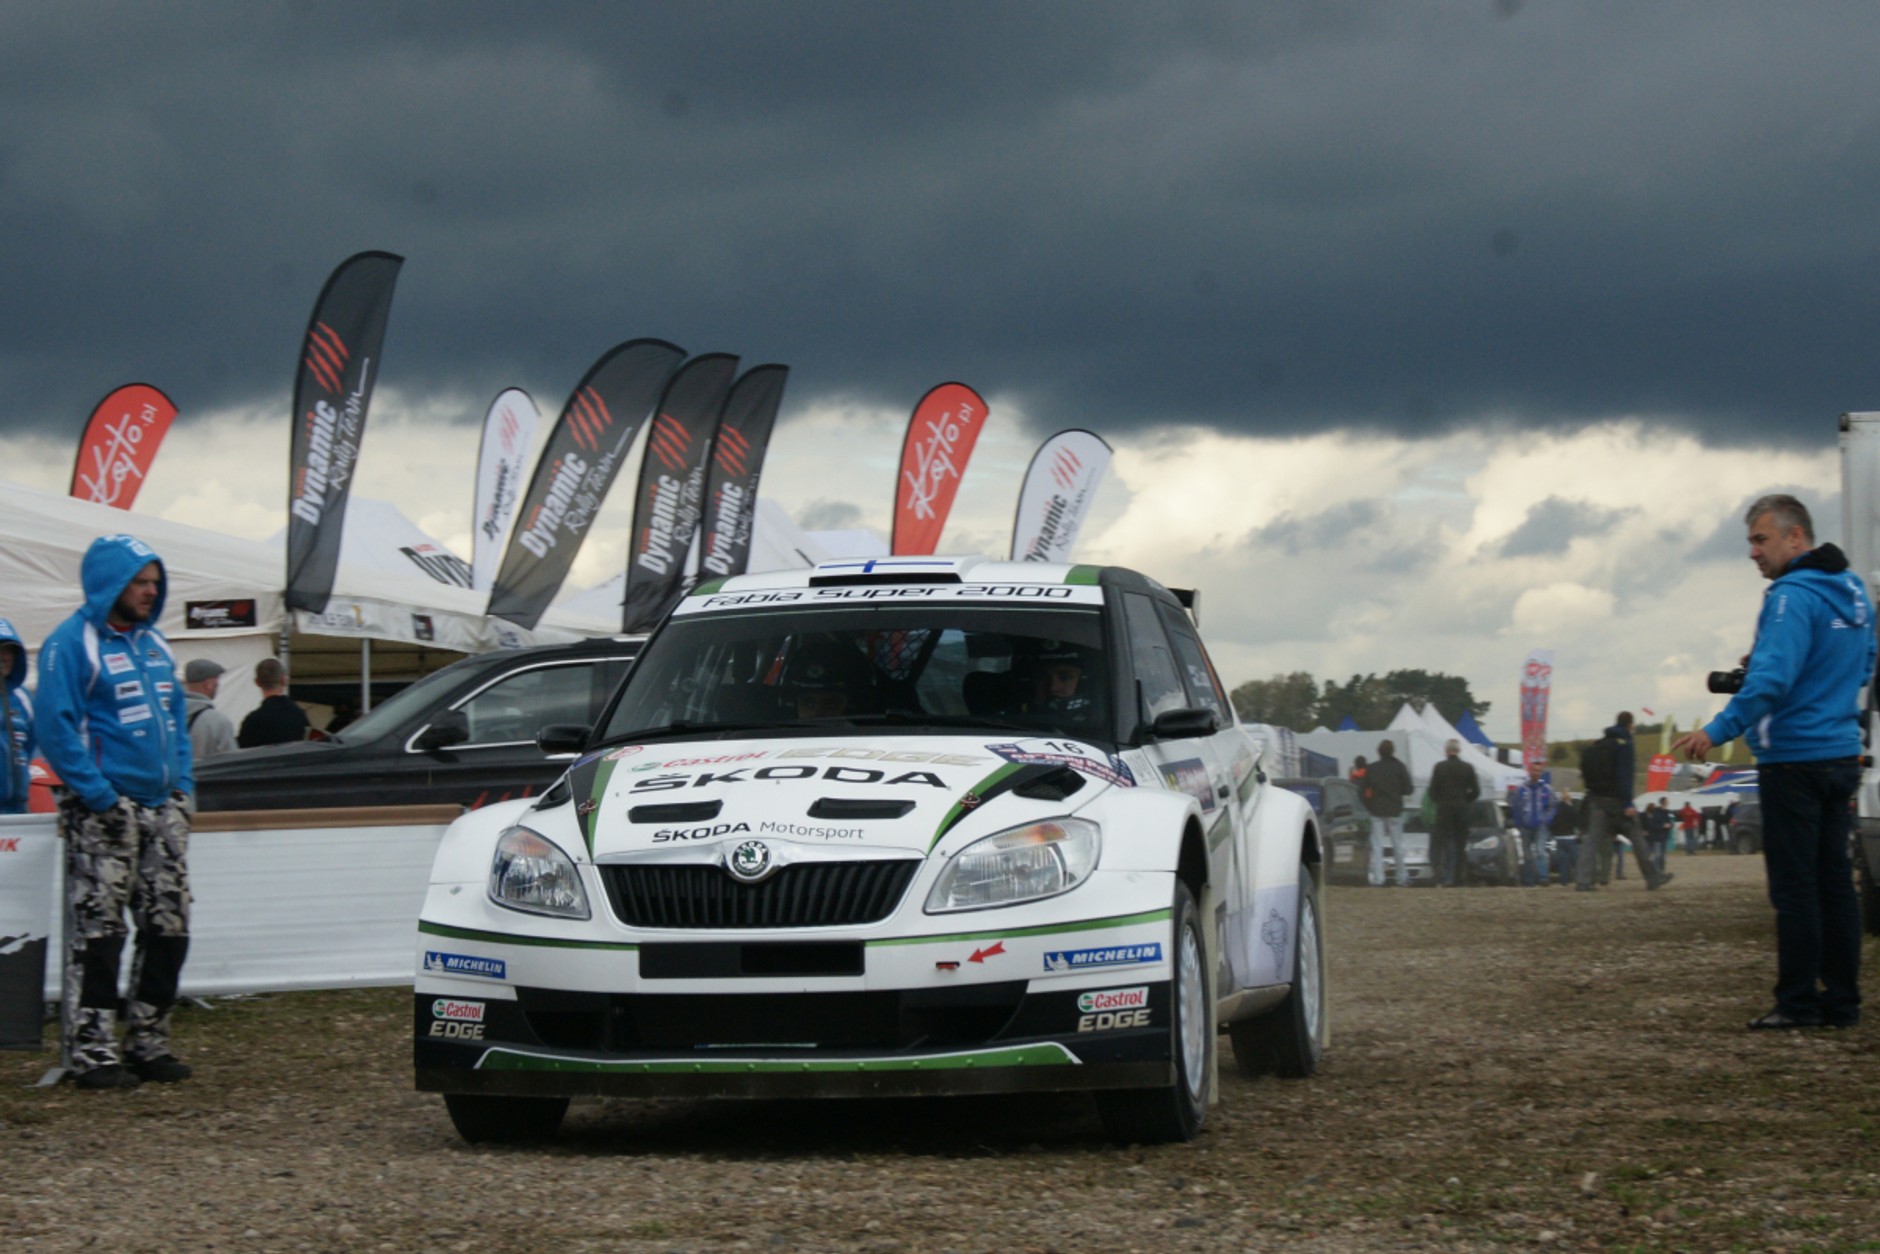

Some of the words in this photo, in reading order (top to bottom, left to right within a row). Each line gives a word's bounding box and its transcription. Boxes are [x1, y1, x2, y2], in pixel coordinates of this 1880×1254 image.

[292, 400, 337, 526] Dynamic
[518, 452, 588, 559] Dynamic
[637, 474, 681, 575] Dynamic
[703, 482, 744, 575] Dynamic
[702, 591, 803, 609] Fabia
[814, 585, 947, 606] Super
[955, 585, 1074, 599] 2000
[663, 750, 769, 769] Castrol
[776, 746, 993, 768] EDGE
[1044, 741, 1084, 755] 16
[627, 765, 949, 795] ŠKODA
[651, 821, 752, 844] ŠKODA
[759, 820, 865, 841] Motorsport
[446, 957, 503, 974] MICHELIN
[1071, 946, 1156, 964] MICHELIN
[445, 1001, 482, 1019] Castrol
[1094, 990, 1144, 1009] Castrol
[428, 1020, 487, 1041] EDGE
[1077, 1008, 1153, 1033] EDGE
